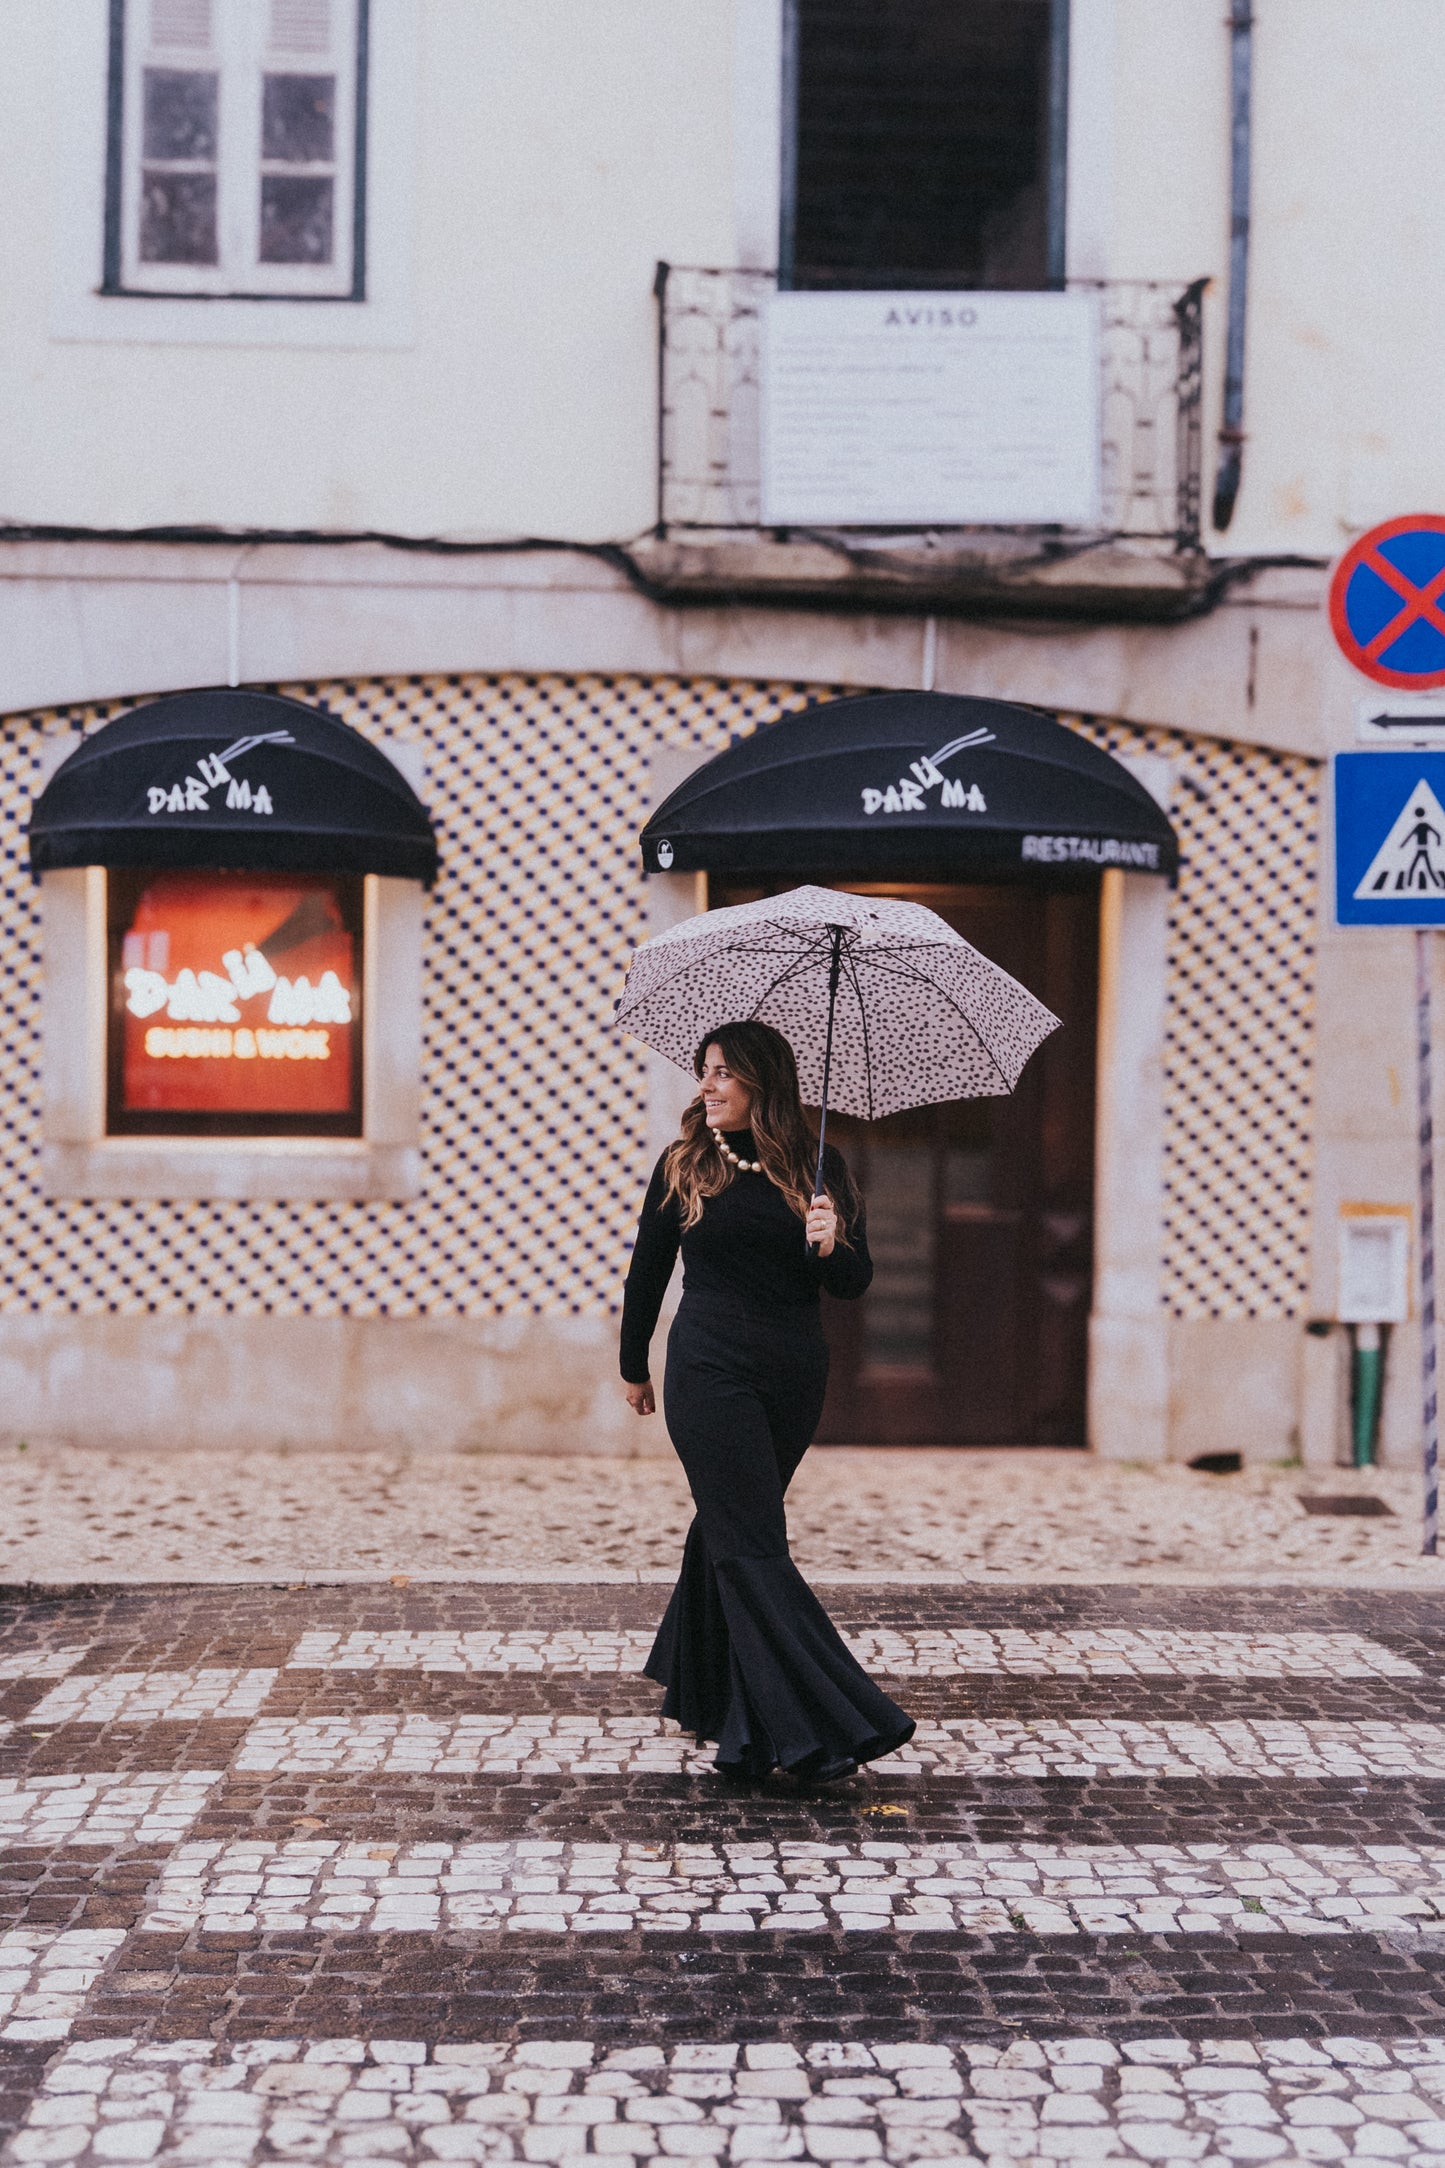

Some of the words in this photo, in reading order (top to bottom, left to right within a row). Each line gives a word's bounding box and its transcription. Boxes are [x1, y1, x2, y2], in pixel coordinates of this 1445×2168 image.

[885, 308, 978, 326] AVISO
[147, 752, 273, 814] DARUMA
[861, 756, 987, 814] DARUMA
[1021, 835, 1160, 869] RESTAURANTE
[124, 949, 351, 1025] DARUMA
